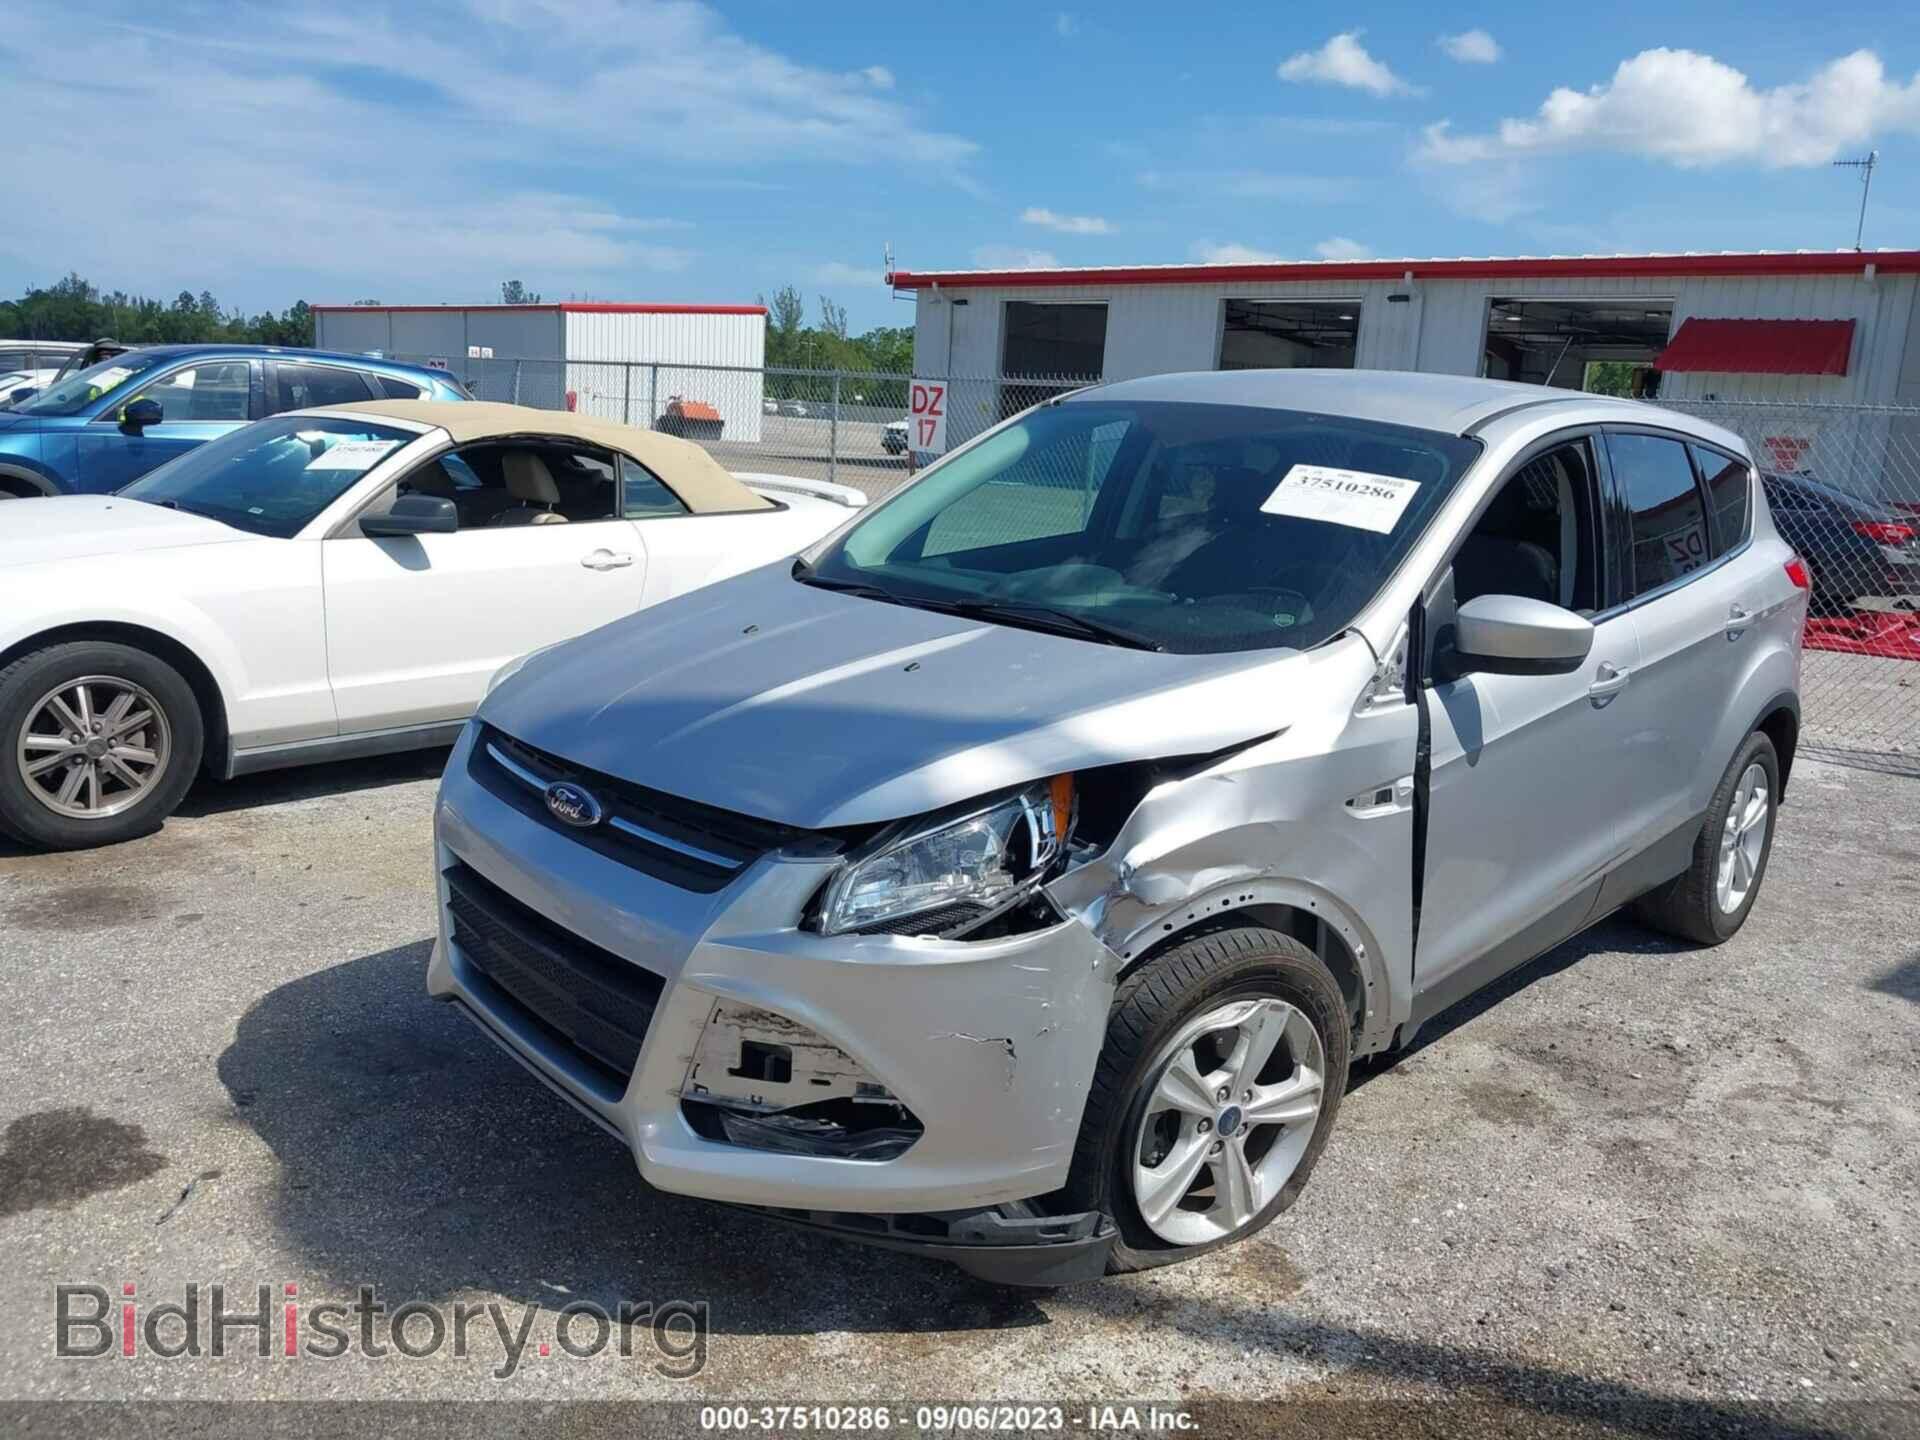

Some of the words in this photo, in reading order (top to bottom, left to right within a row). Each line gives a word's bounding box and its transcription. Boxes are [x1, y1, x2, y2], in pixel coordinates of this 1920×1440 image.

[912, 384, 944, 416] DZ
[918, 418, 937, 447] 17
[1300, 476, 1395, 499] 37510286
[552, 788, 583, 818] Ford
